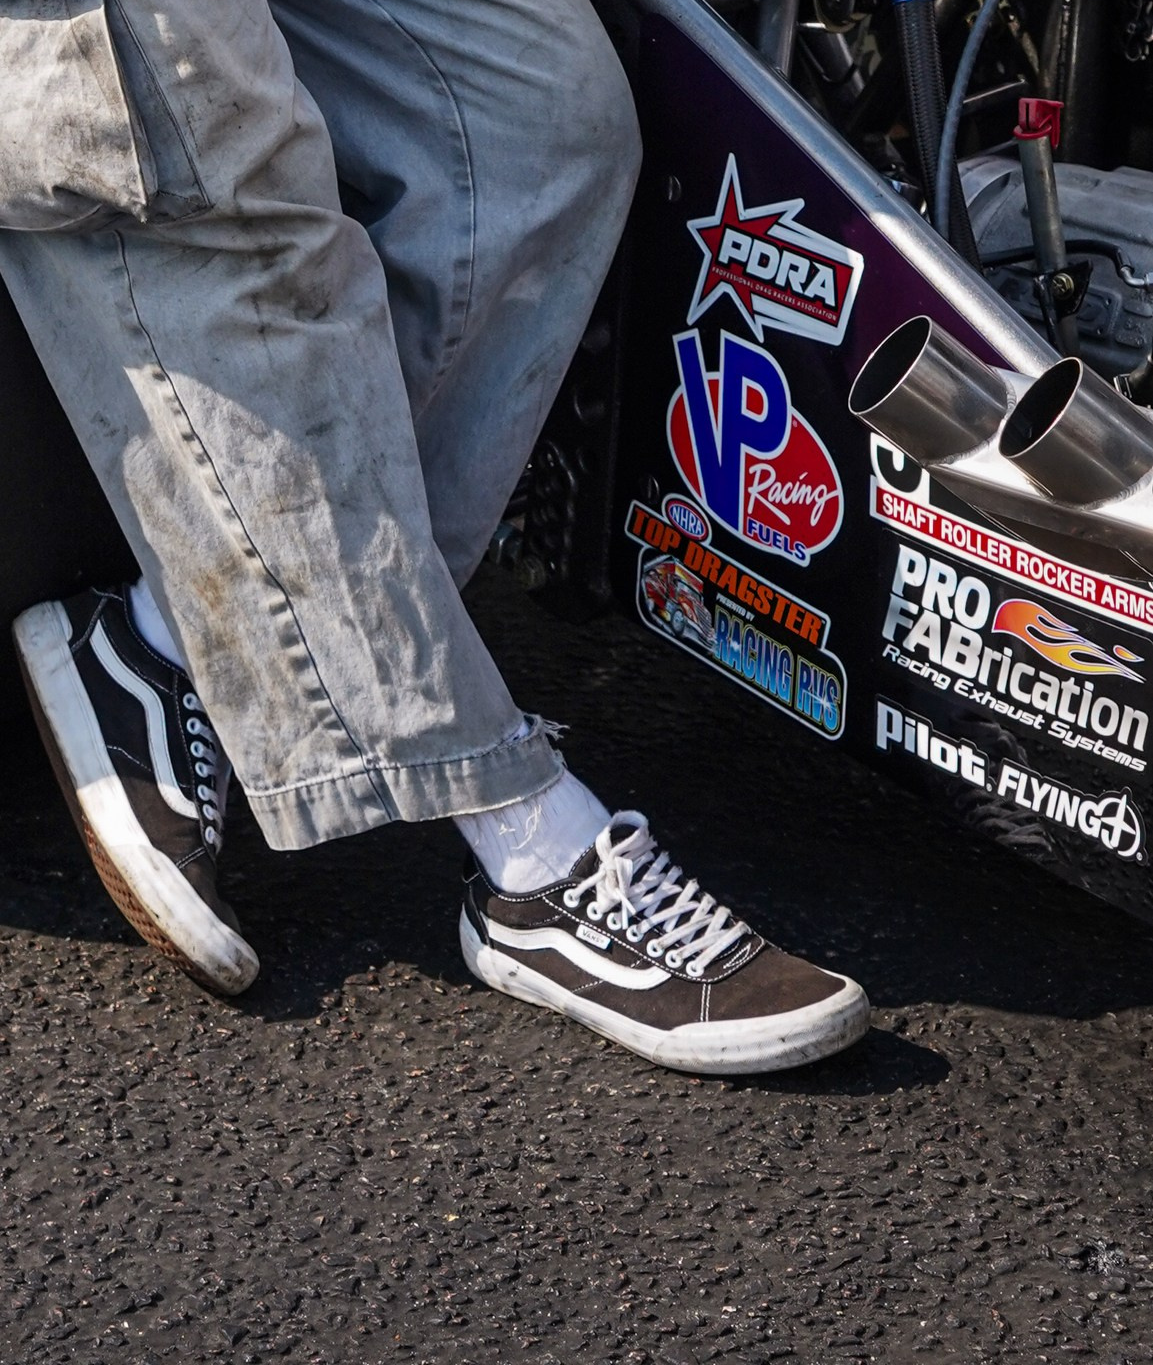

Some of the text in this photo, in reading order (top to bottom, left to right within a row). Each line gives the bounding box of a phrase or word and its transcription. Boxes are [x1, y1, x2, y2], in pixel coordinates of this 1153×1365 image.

[711, 266, 837, 321] PROFESSIONAL DRAG RACERS ASSOCIATION
[717, 227, 836, 308] PDRA
[675, 332, 790, 532] VP
[671, 505, 704, 536] NHRA
[748, 463, 838, 526] Racing
[632, 507, 824, 646] TOP DRAGSTER
[747, 517, 806, 561] FUELS
[882, 493, 1153, 624] SHAFT ROLLER ROCKER ARMS
[892, 543, 991, 630] PRO
[713, 603, 841, 732] RACING RVS
[882, 592, 1150, 752] FABrication
[882, 643, 1148, 772] Racing Exhaust Systems
[998, 764, 1102, 836] FLYING
